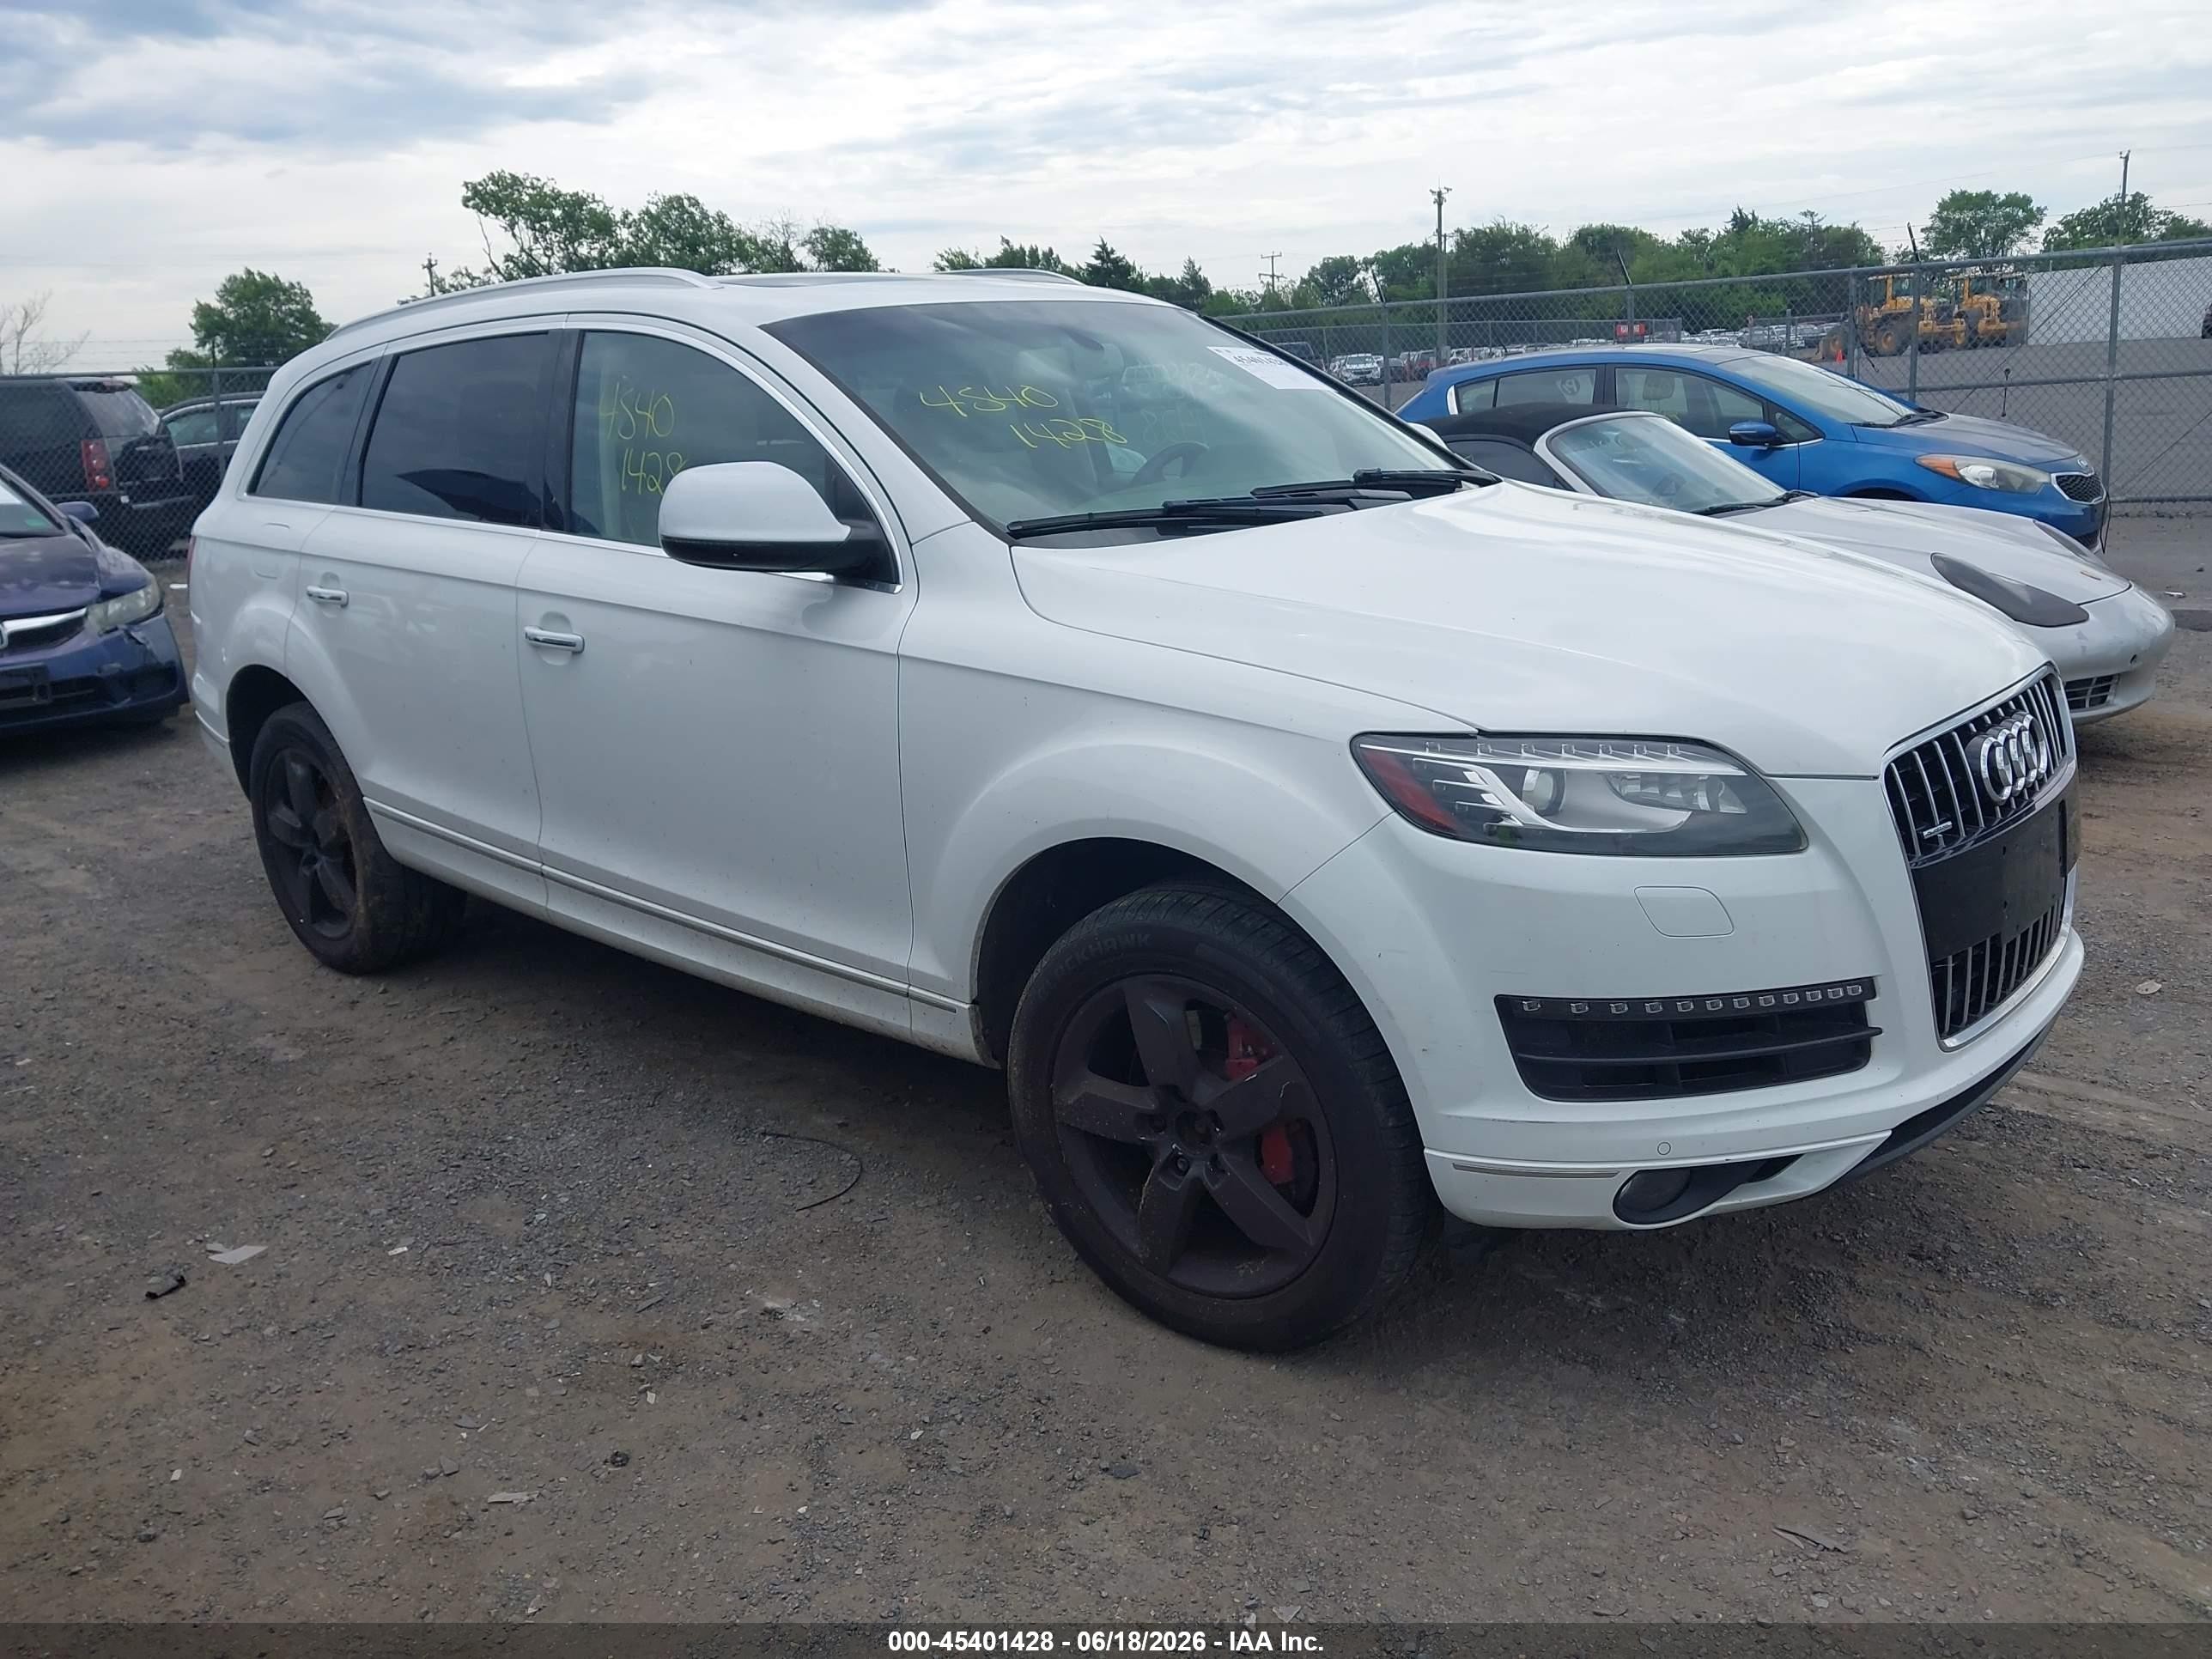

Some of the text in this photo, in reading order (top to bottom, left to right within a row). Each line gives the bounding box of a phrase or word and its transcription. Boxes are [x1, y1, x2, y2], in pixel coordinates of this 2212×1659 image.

[599, 381, 675, 440] 4540
[920, 386, 1058, 417] 4540
[1010, 418, 1127, 449] 1428
